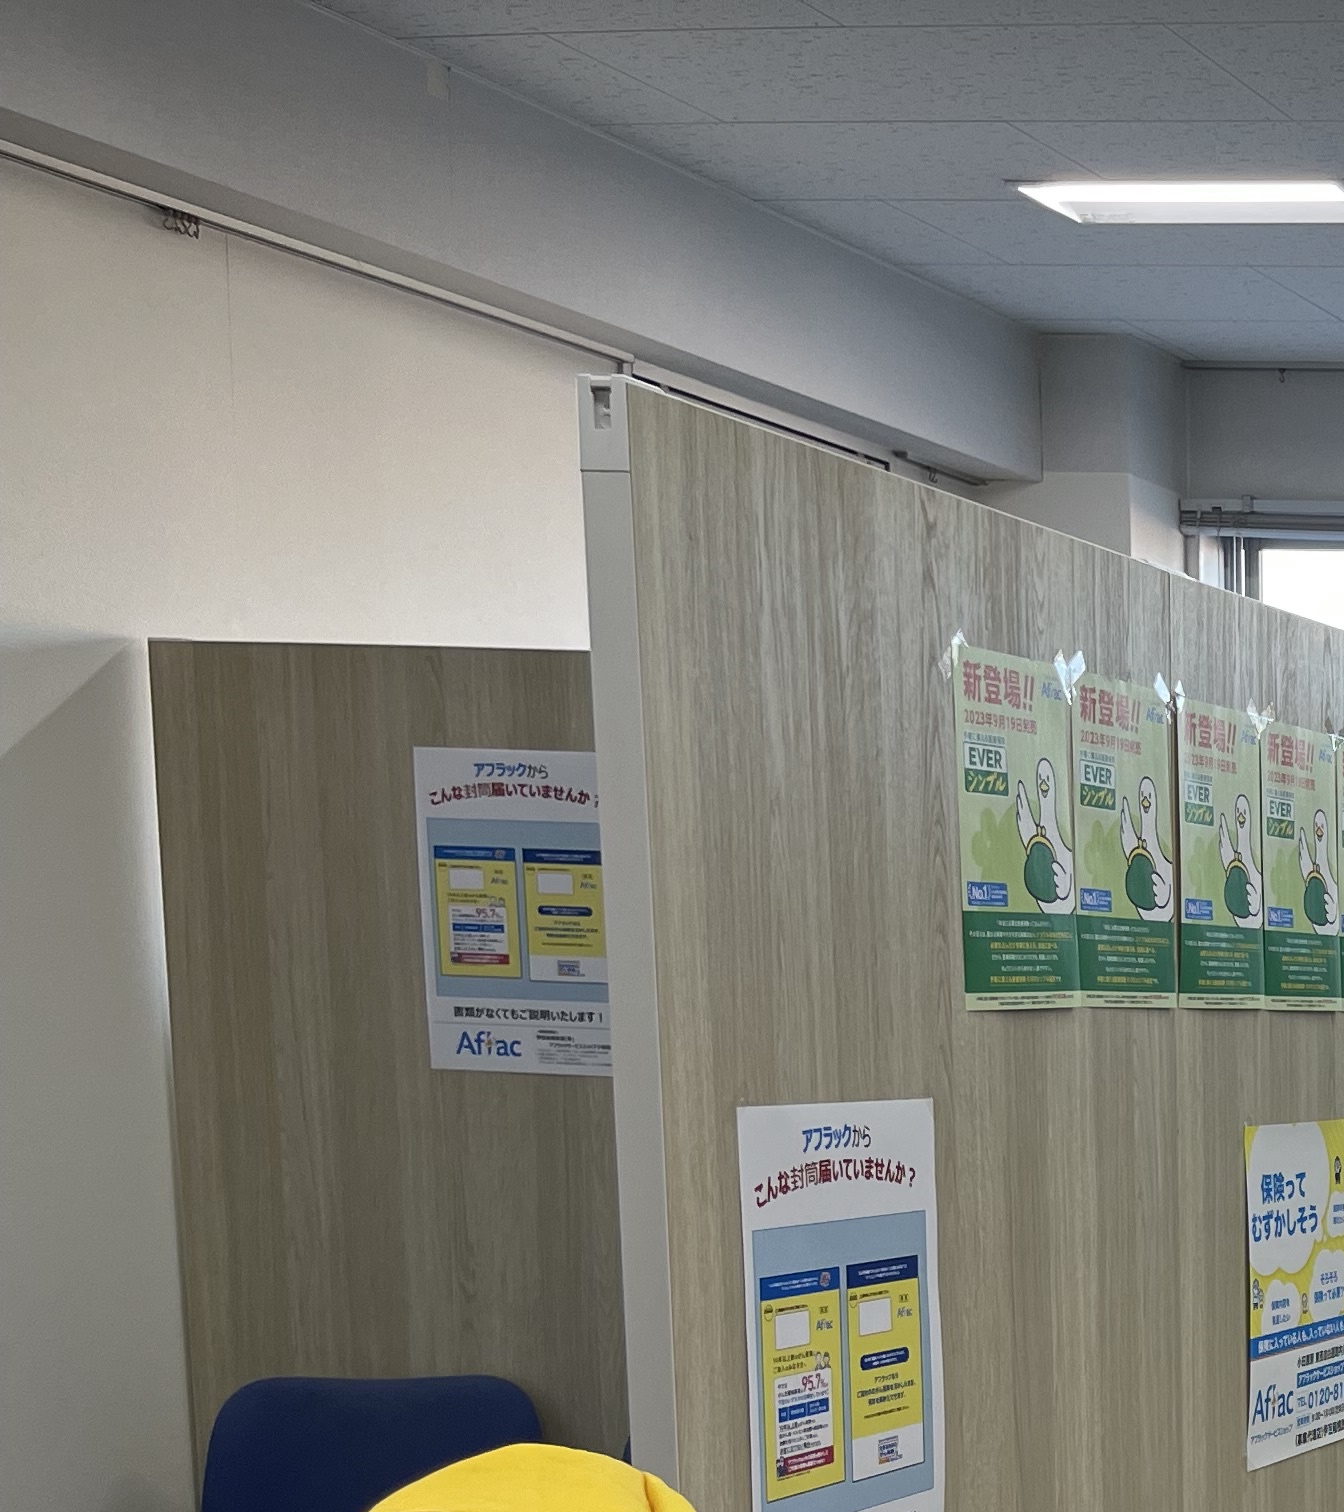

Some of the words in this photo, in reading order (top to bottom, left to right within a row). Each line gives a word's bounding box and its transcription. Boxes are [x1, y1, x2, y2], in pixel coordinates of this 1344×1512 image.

[962, 659, 1034, 712] 新登場!!
[1079, 685, 1141, 734] 新登場!!
[1184, 712, 1237, 754] 新登場!!
[969, 747, 1003, 769] EVER
[1267, 733, 1313, 774] 新登場!!
[473, 763, 549, 779] アフラックから
[968, 771, 1006, 792] シンプル
[1084, 765, 1112, 785] EVER
[1082, 788, 1114, 806] シンプル
[1187, 784, 1210, 803] EVER
[1186, 806, 1212, 824] シンプル
[1269, 800, 1292, 818] EVER
[1268, 820, 1293, 837] シンプル
[456, 1030, 522, 1057] Aflac
[802, 1124, 871, 1152] アフラックから
[754, 1157, 915, 1208] こんな封筒届いていませんか？
[1261, 1172, 1306, 1205] 保険って
[1252, 1205, 1318, 1242] むずかしそう
[1252, 1384, 1294, 1425] Aflac
